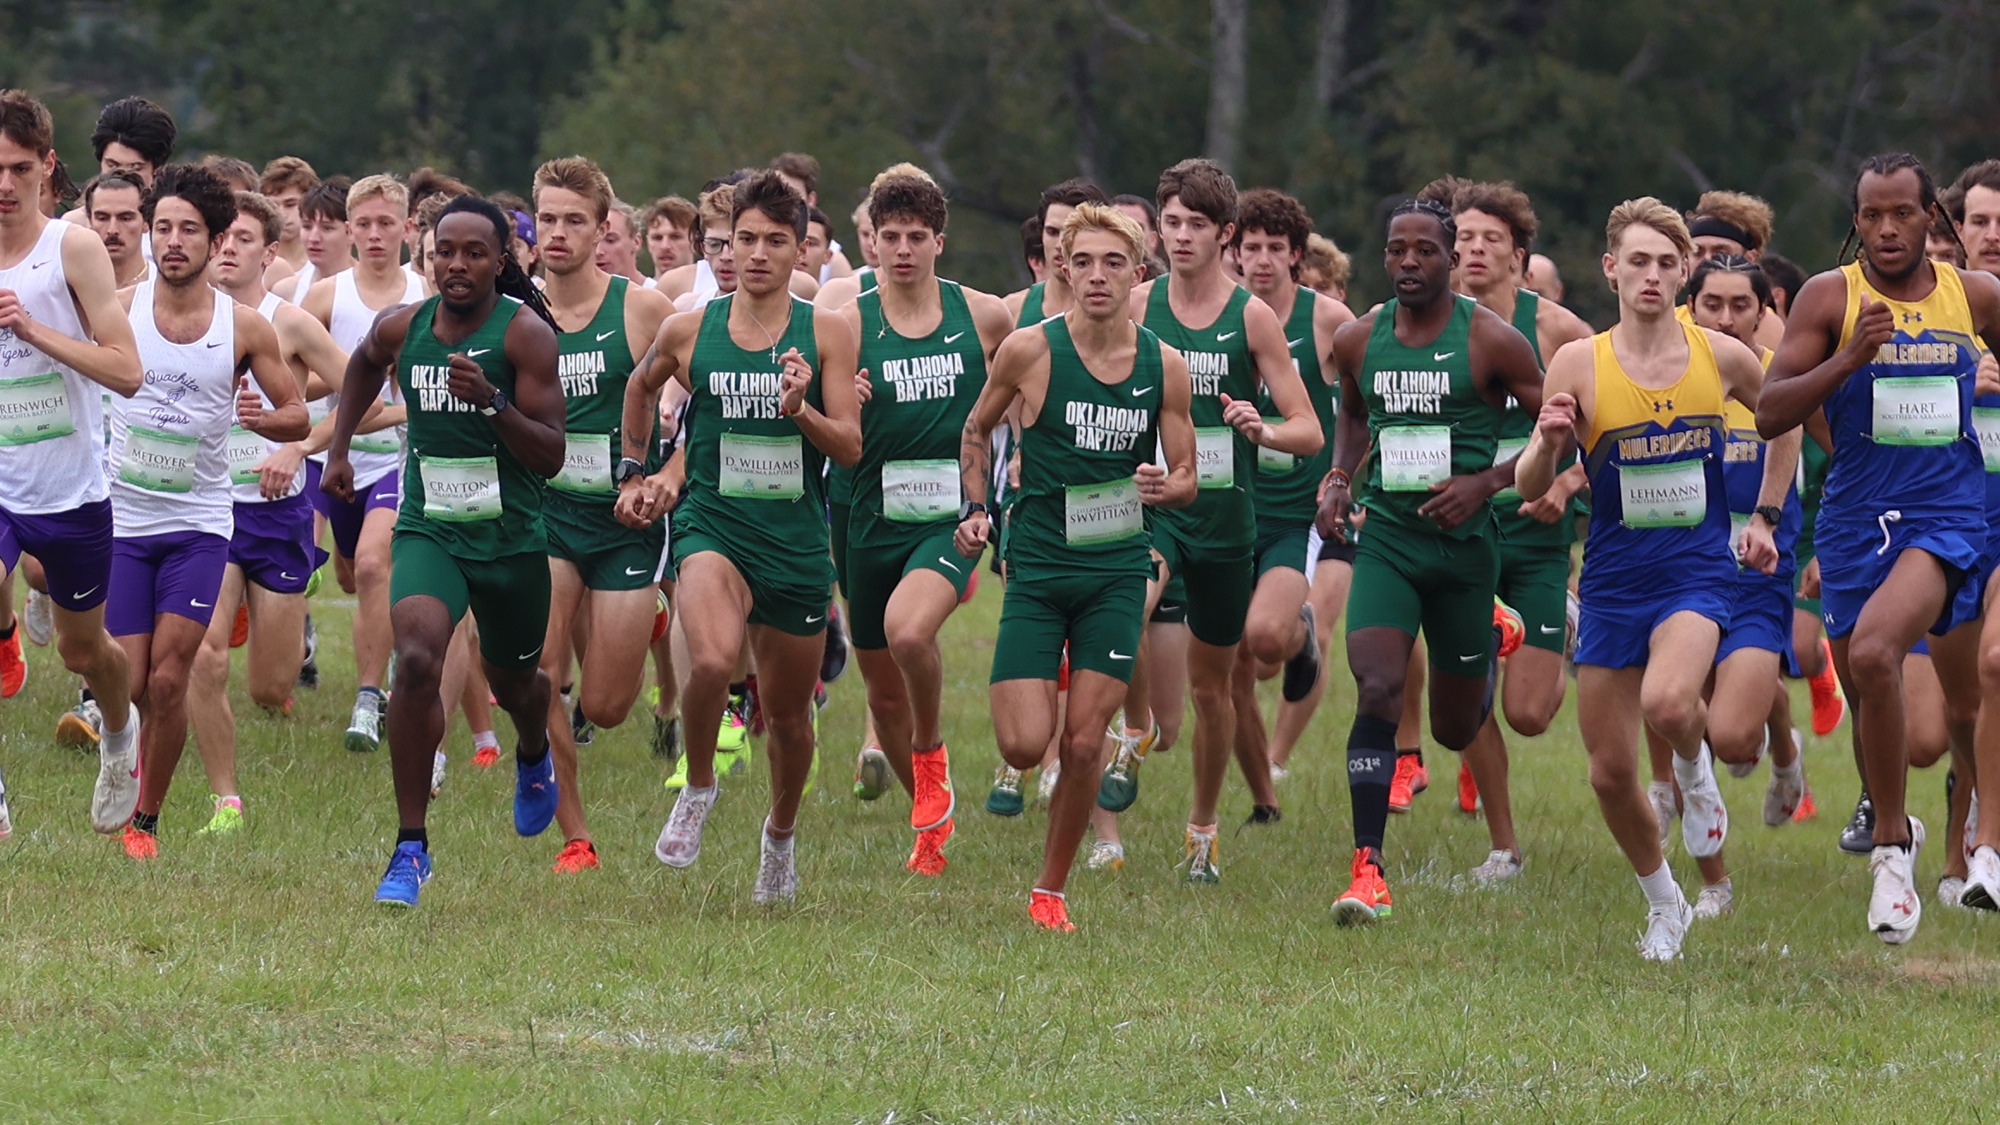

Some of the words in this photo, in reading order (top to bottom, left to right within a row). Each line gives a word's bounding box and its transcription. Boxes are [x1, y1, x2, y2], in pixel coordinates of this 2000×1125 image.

[558, 350, 606, 376] AHOMA
[1183, 350, 1229, 376] AHOMA
[1870, 343, 1957, 365] MULERIDERS
[411, 364, 450, 389] OKLA
[882, 352, 964, 383] OKLAHOMA
[145, 369, 200, 393] Ouachita
[560, 373, 598, 398] PTIST
[709, 371, 783, 396] OKLAHOM
[894, 375, 957, 402] BAPTIST
[1190, 373, 1221, 396] TIST
[1373, 371, 1450, 395] OKLAHOMA
[0, 396, 64, 416] REENWICH
[1383, 393, 1442, 414] BAPTIST
[1899, 402, 1936, 414] HART
[149, 406, 190, 428] Tigers
[1065, 401, 1148, 432] OKLAHOMA
[1075, 425, 1138, 451] BAPTIST
[1618, 427, 1711, 460] MULERIDERS
[132, 448, 187, 468] METOYER
[229, 445, 261, 458] ITAGE
[1197, 449, 1219, 460] NES
[1390, 449, 1447, 460] WILLIAMS
[725, 456, 737, 468] D.
[739, 457, 800, 471] WILLIAMS
[429, 480, 489, 493] CRAYTON
[900, 481, 942, 492] WHITE
[1630, 483, 1699, 499] LEHMANN
[1070, 506, 1130, 524] WILLIAMS
